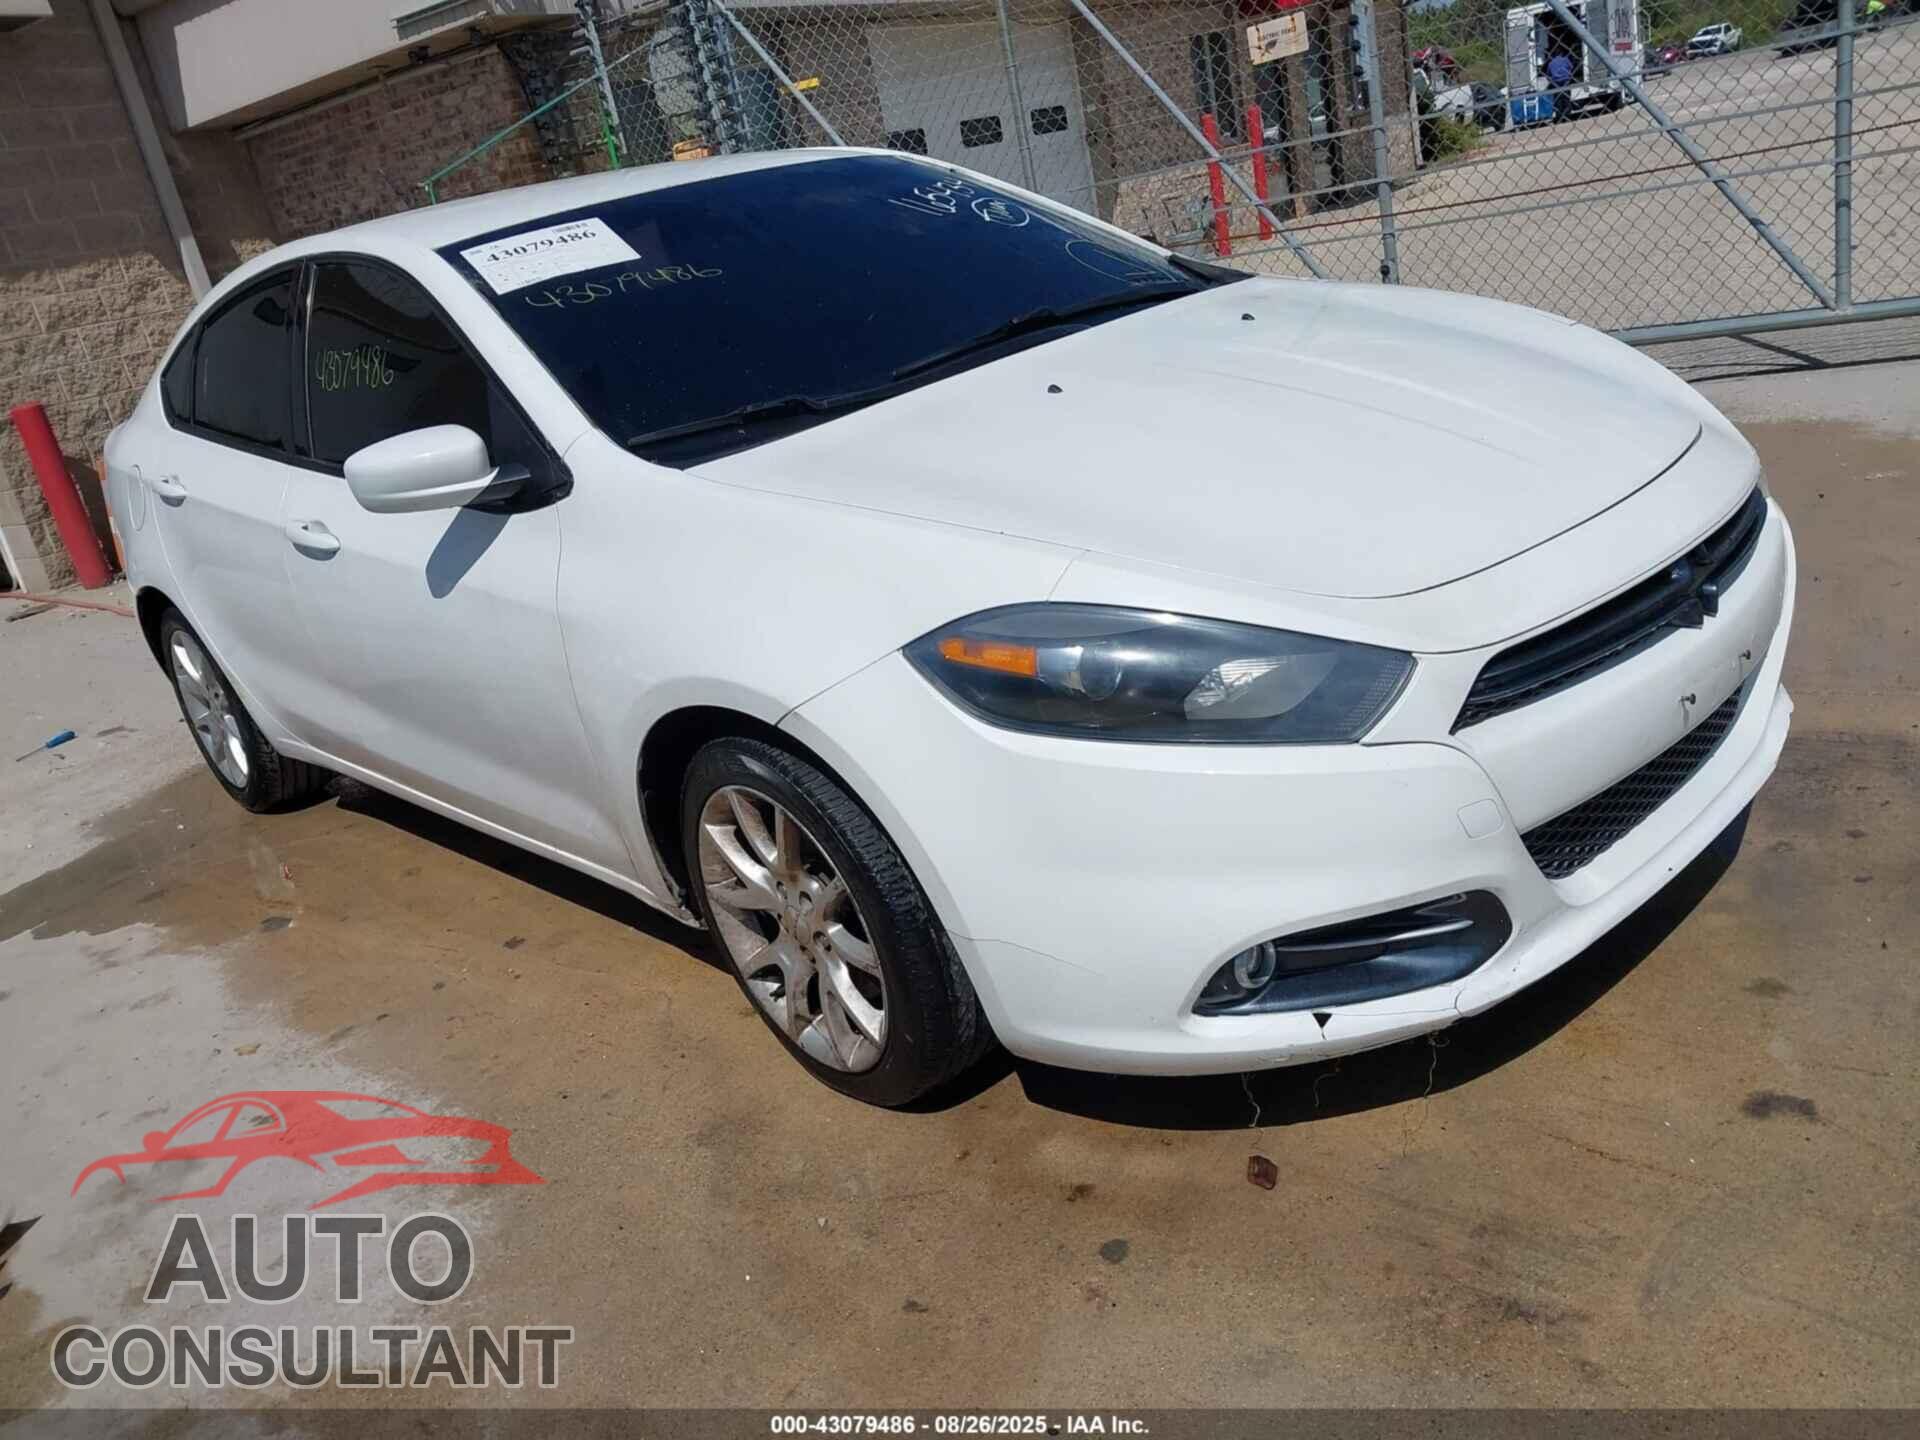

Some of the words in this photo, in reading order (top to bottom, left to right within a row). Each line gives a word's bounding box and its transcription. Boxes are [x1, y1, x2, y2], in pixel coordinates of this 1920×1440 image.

[486, 229, 598, 263] 43079486
[524, 263, 723, 309] 43079486
[315, 344, 395, 391] 43079486
